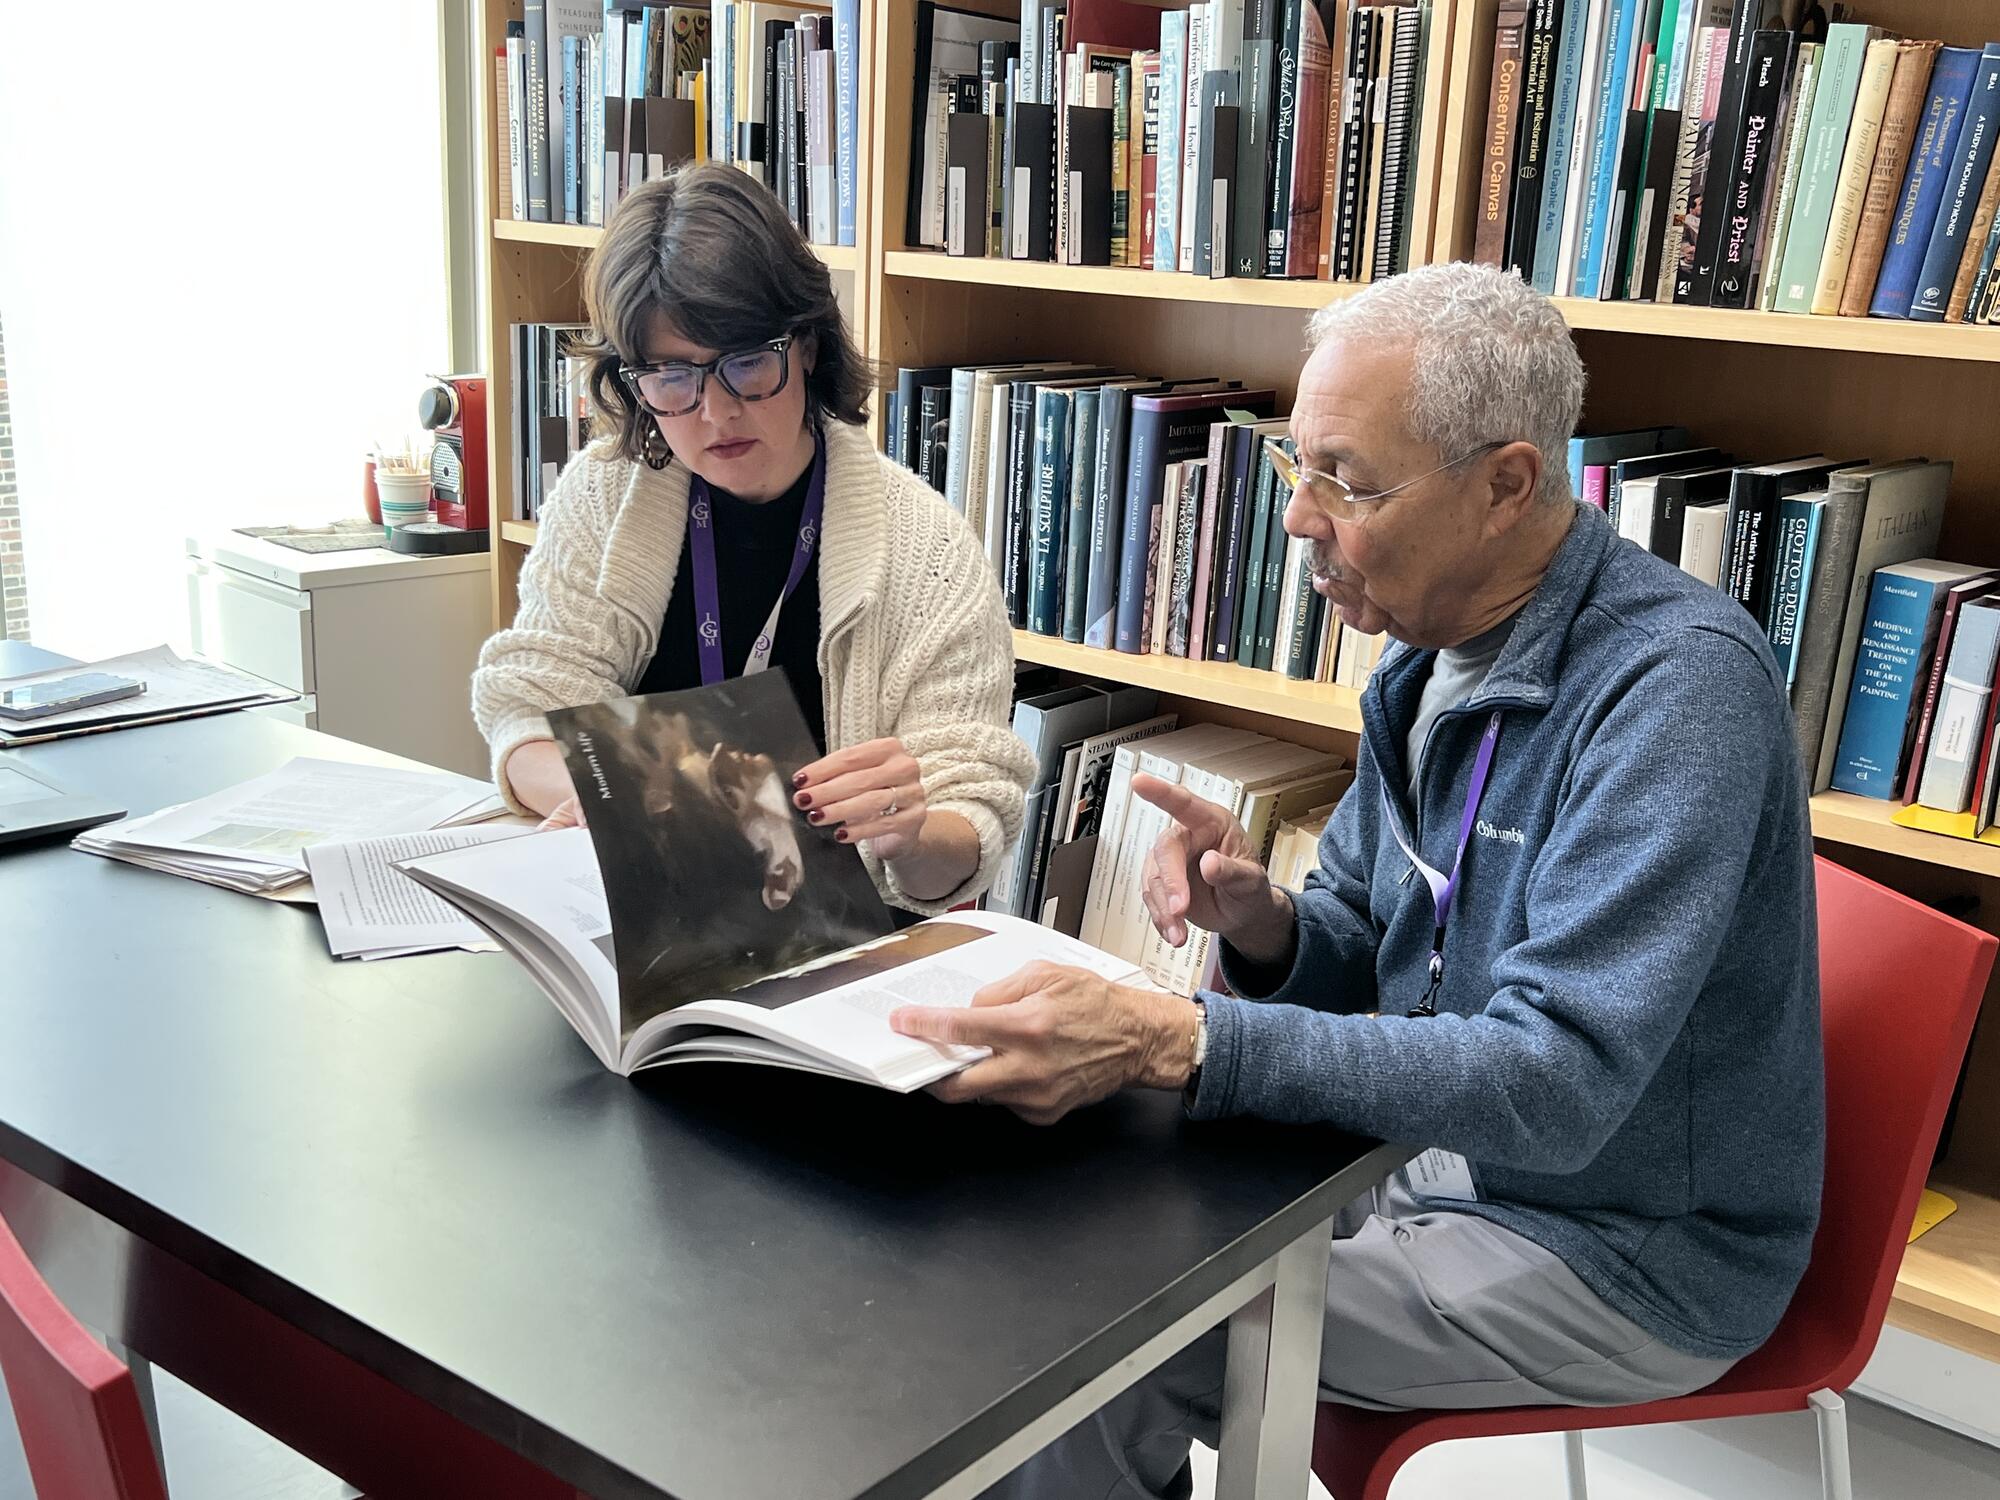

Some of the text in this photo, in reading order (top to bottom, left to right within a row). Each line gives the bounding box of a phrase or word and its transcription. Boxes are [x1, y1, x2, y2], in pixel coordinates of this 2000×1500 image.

[1534, 9, 1544, 31] Smith
[1525, 34, 1542, 103] of Pictorial Art
[1735, 36, 1744, 64] Restored
[1023, 50, 1033, 91] BOOK
[1651, 62, 1666, 113] MEASURE
[1698, 50, 1710, 94] MATERIALS
[1758, 56, 1773, 88] Plesch
[536, 78, 545, 132] TREASURES
[1113, 78, 1121, 104] What
[1184, 17, 1201, 169] Identifying Wood Hoadley
[1528, 34, 1553, 163] Conservation and Restoration
[840, 22, 850, 208] STAINED GLASS WINDOWS
[1323, 69, 1341, 197] THE COLOR OF LIFE
[1544, 0, 1582, 232] onservation of Paintings and the Graphic Arts
[1580, 10, 1621, 260] Historical Painting Techniques, Materials, and Studio Practice
[1931, 96, 1959, 169] A Dictionary of
[510, 119, 519, 166] Ceramics
[1112, 147, 1120, 174] that?
[1485, 59, 1515, 222] Conserving Canvas
[1848, 118, 1877, 185] Formulas
[1675, 116, 1700, 212] PAINTING
[1893, 94, 1944, 246] ART TERMS and TECHNIQUES
[1945, 114, 1986, 238] A STUDY OF RICHARD SYMONDS
[1158, 167, 1173, 228] WOOD
[1724, 114, 1766, 264] Painter AND Priest
[1842, 183, 1862, 208] for
[1830, 205, 1854, 259] painters
[921, 439, 932, 473] Bernini
[1102, 428, 1111, 450] Italian
[1133, 434, 1146, 476] ILLUSION
[1012, 470, 1023, 514] Polychromie
[1097, 465, 1108, 491] Spanish
[1036, 463, 1057, 553] LA SCULPTURE
[1093, 492, 1108, 553] SCULPTURE
[1127, 494, 1141, 540] IMITATION
[1787, 518, 1795, 532] Early
[1876, 508, 1929, 540] ITALIAN
[1011, 522, 1021, 553] Historical
[1170, 485, 1188, 602] METHODS OF SCULPTURE
[1177, 495, 1195, 595] THE MATERIALS AND
[1740, 519, 1750, 541] Painting
[1783, 533, 1794, 563] Renaissance
[1730, 555, 1738, 575] Selected
[1737, 540, 1747, 567] Instruction
[1742, 511, 1761, 601] The Artist's Assistant
[1817, 502, 1846, 615] ITALIAN PAINTINGS
[1008, 555, 1019, 595] Polychromy
[1732, 588, 1740, 599] and
[1779, 564, 1789, 586] Painting
[1779, 517, 1808, 647] GIOTTO TO DÜRER
[1883, 585, 1918, 598] Merrifield
[1290, 569, 1313, 658] DELLA ROBBIAS IN
[1774, 603, 1784, 626] National
[1873, 620, 1913, 635] MEDIEVAL
[1771, 626, 1781, 644] Gallery
[1862, 637, 1916, 656] RENAISSANCE
[1882, 633, 1900, 641] AND
[1865, 668, 1903, 682] THE ARTS
[1867, 649, 1907, 665] TREATISES
[1879, 662, 1892, 671] ON
[1860, 685, 1900, 700] PAINTING
[1876, 680, 1889, 688] OF
[1087, 721, 1177, 755] STEINKONSERVIERUNG
[577, 732, 613, 799] Modern Life
[1204, 777, 1210, 786] 2
[1196, 936, 1208, 968] Objects
